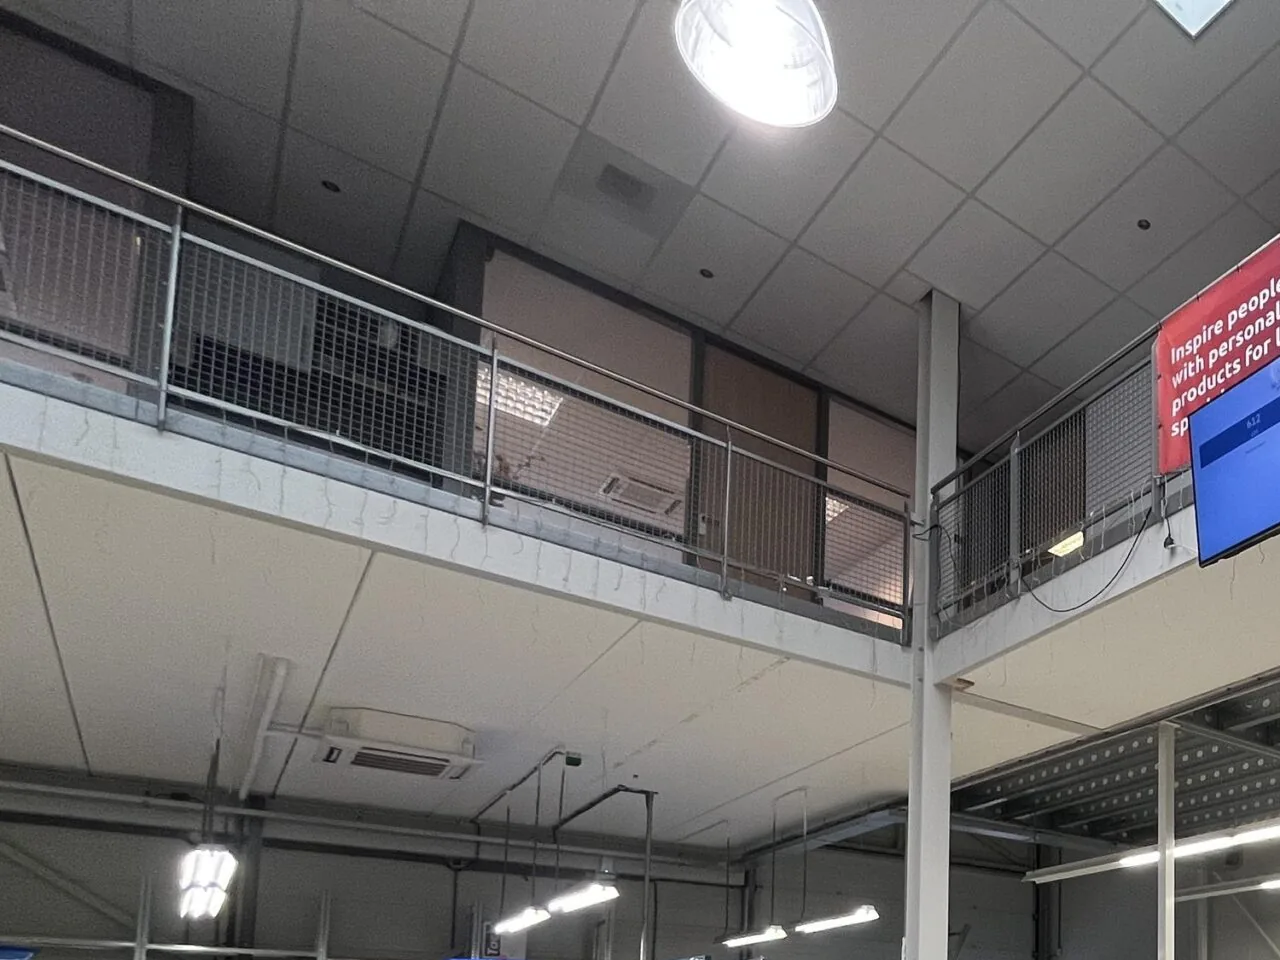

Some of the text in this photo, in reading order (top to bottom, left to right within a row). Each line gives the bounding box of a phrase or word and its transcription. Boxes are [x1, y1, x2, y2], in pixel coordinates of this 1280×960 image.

[1171, 319, 1224, 365] Inspire
[1172, 354, 1205, 388] with
[1172, 358, 1242, 417] products
[1245, 338, 1272, 367] for
